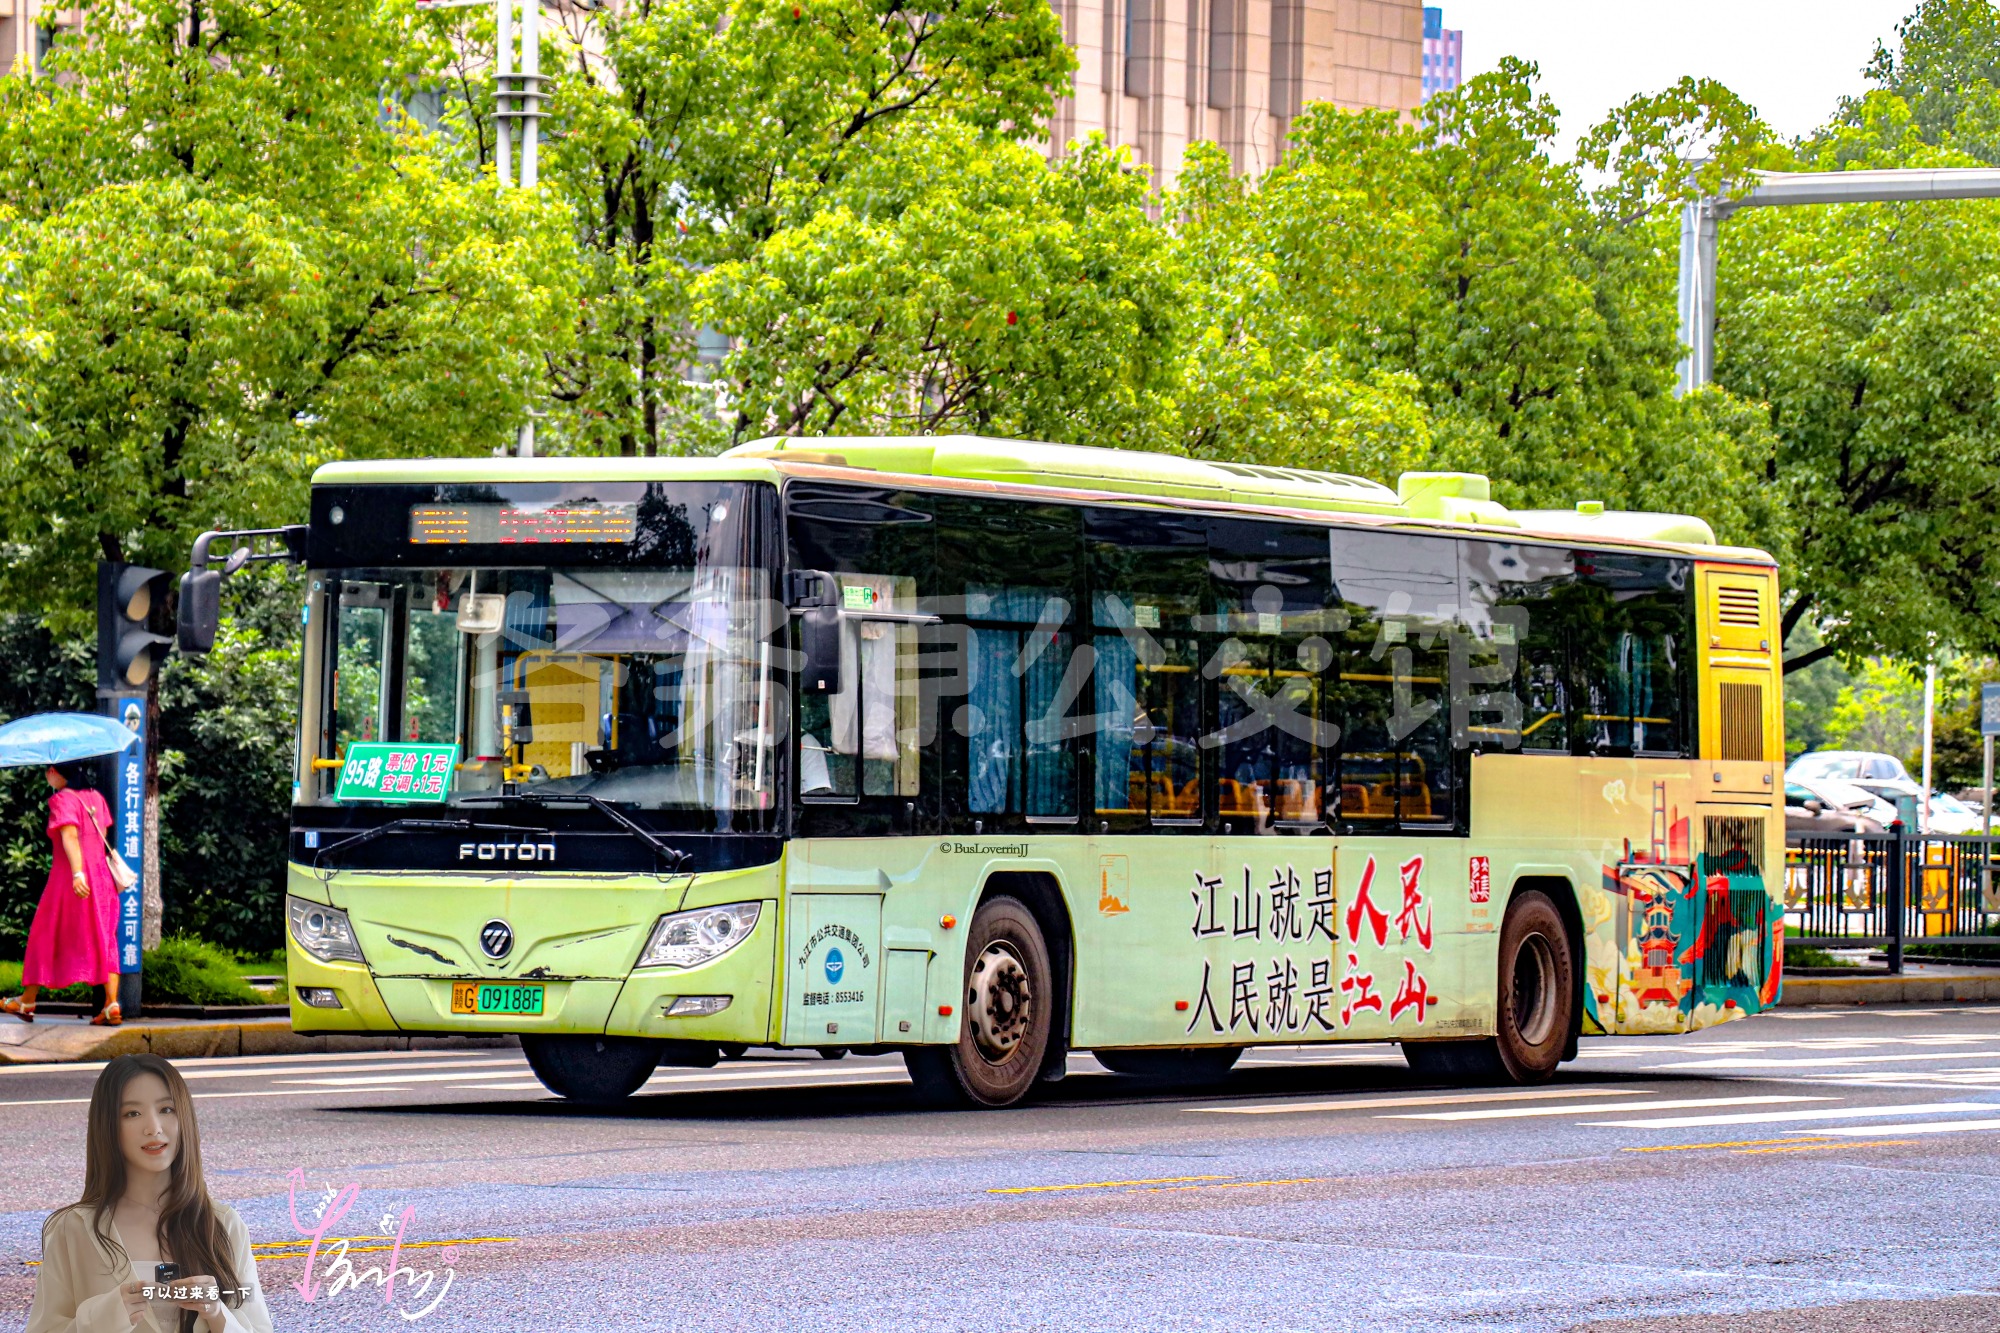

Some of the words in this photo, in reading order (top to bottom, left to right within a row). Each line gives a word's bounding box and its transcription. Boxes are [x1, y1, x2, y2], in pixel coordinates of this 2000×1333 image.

[345, 756, 383, 788] 95路
[124, 762, 141, 858] 各行其道
[459, 843, 556, 861] FOTON
[1190, 854, 1434, 952] 江山就是人民
[798, 924, 870, 969] 九江市公共交通集团公司
[1186, 952, 1428, 1035] 人民就是江山
